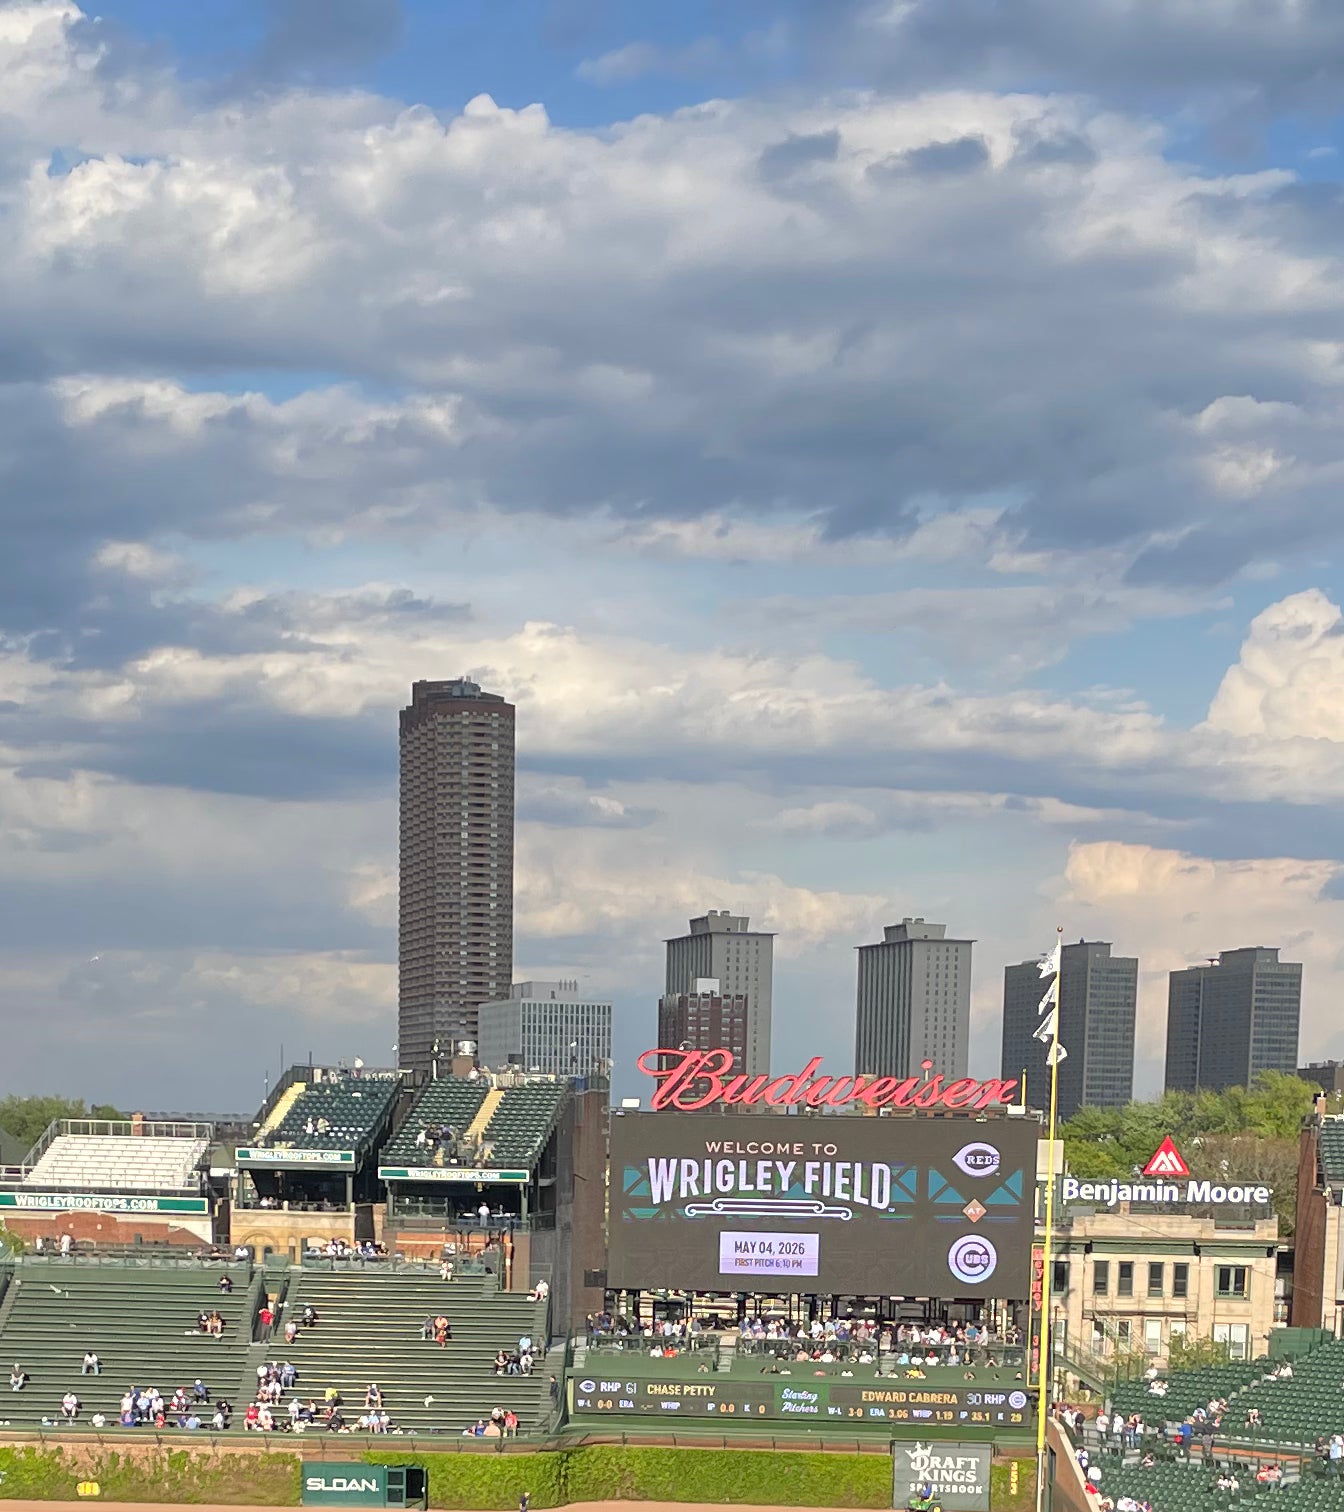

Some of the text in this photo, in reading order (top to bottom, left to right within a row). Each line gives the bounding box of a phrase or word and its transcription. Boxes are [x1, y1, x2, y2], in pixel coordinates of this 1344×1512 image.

[637, 1048, 1018, 1111] Budweiser
[705, 1140, 838, 1156] WELCOME TO
[966, 1155, 1000, 1165] REDS
[648, 1157, 891, 1210] WRIGLEY FIELD
[1063, 1178, 1270, 1206] Benjamin Moore
[14, 1194, 158, 1210] WRIGLEYROOFTOPS.COM
[734, 1241, 805, 1255] MAY 04, 2026
[735, 1258, 753, 1267] FIRST
[754, 1258, 774, 1267] PITCH
[791, 1260, 802, 1268] PM
[600, 1381, 716, 1397] RHP 61 CHASE PETTY
[781, 1388, 818, 1403] Starting
[861, 1390, 1005, 1405] EDWARD CABRERA 30 RHP
[719, 1403, 735, 1413] 0.0
[744, 1404, 750, 1412] K
[758, 1405, 765, 1414] 0
[781, 1401, 819, 1414] Pitchers
[869, 1408, 885, 1417] ERA
[888, 1408, 908, 1419] 3.06
[935, 1410, 953, 1421] 1.19
[971, 1412, 989, 1422] 35.1
[910, 1455, 980, 1471] DRAFT
[918, 1469, 977, 1482] KINGS
